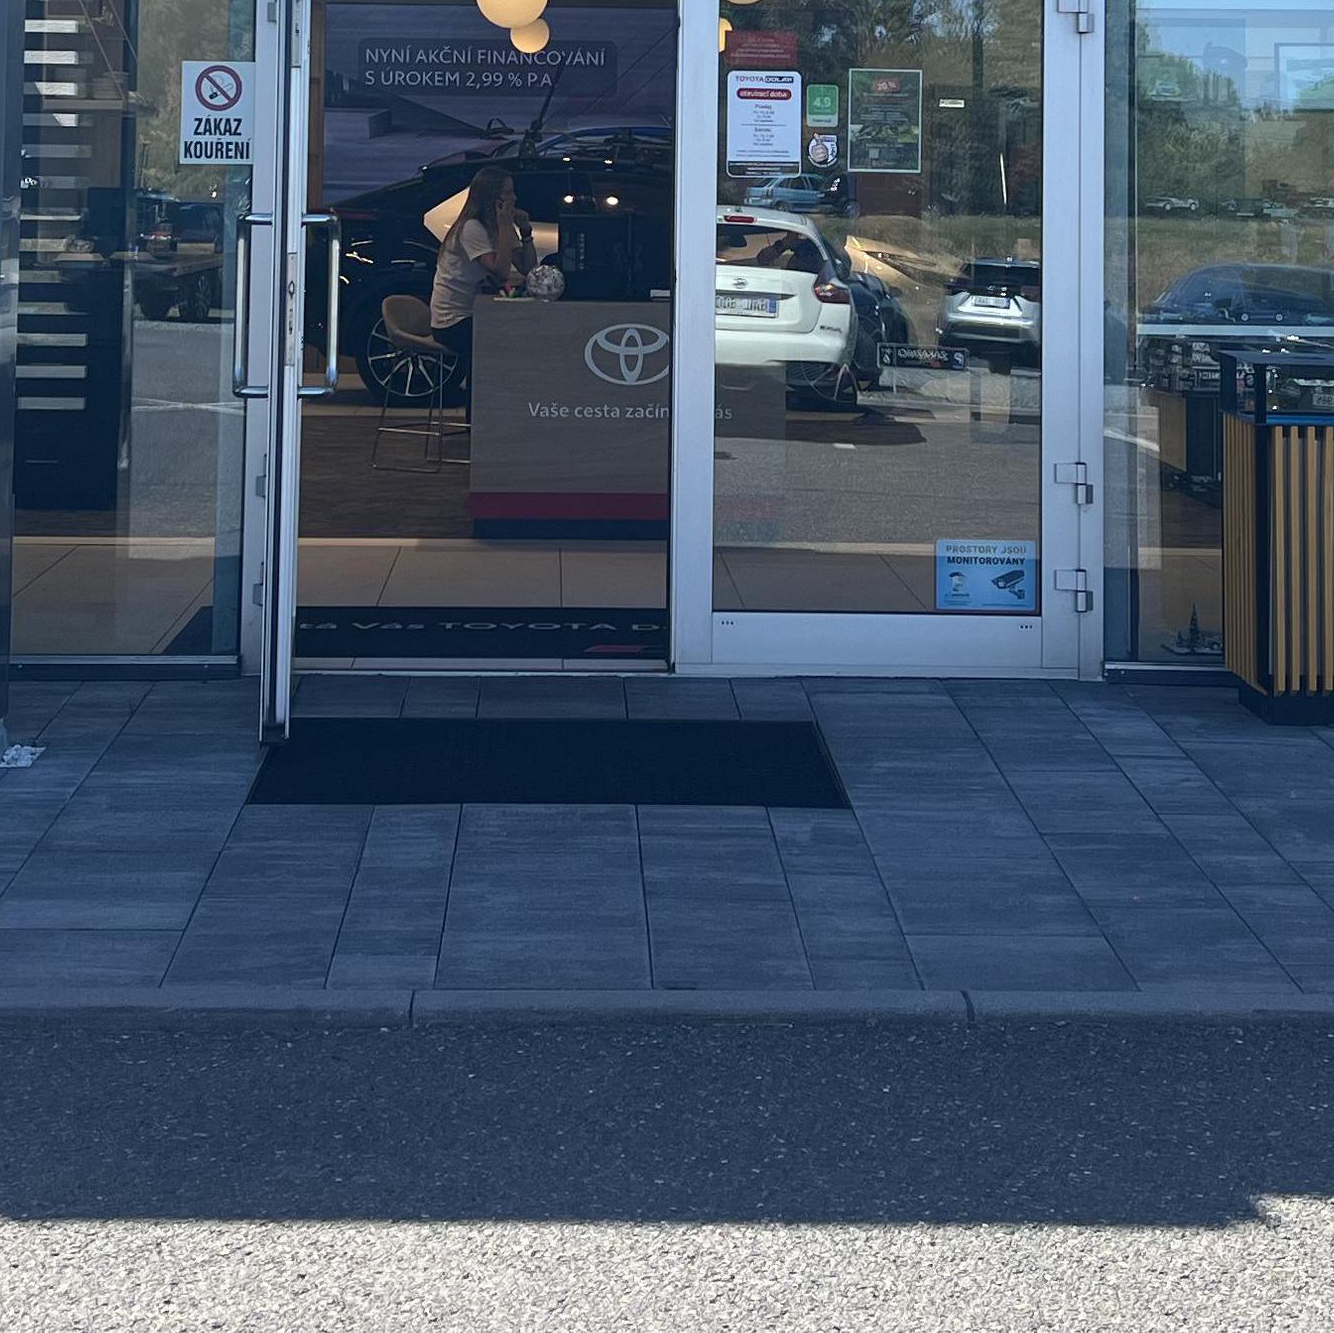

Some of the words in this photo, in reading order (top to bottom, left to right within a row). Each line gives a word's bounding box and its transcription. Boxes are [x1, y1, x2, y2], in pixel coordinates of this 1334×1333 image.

[366, 45, 411, 63] NYNÍ
[416, 46, 473, 64] AKČNÍ
[478, 48, 606, 66] FINANCOVÁNÍ
[365, 70, 375, 86] S
[381, 66, 460, 86] ÚROKEM
[466, 72, 503, 89] 2,99
[508, 72, 522, 87] %
[193, 114, 242, 136] ZÁKAZ
[183, 137, 251, 159] KOUŘENÍ
[528, 402, 569, 418] Vaše
[574, 405, 620, 419] cesta
[625, 403, 670, 419] začín
[946, 545, 997, 554] PROSTORY
[1001, 546, 1026, 554] JSOU
[438, 622, 618, 630] TOYOTA
